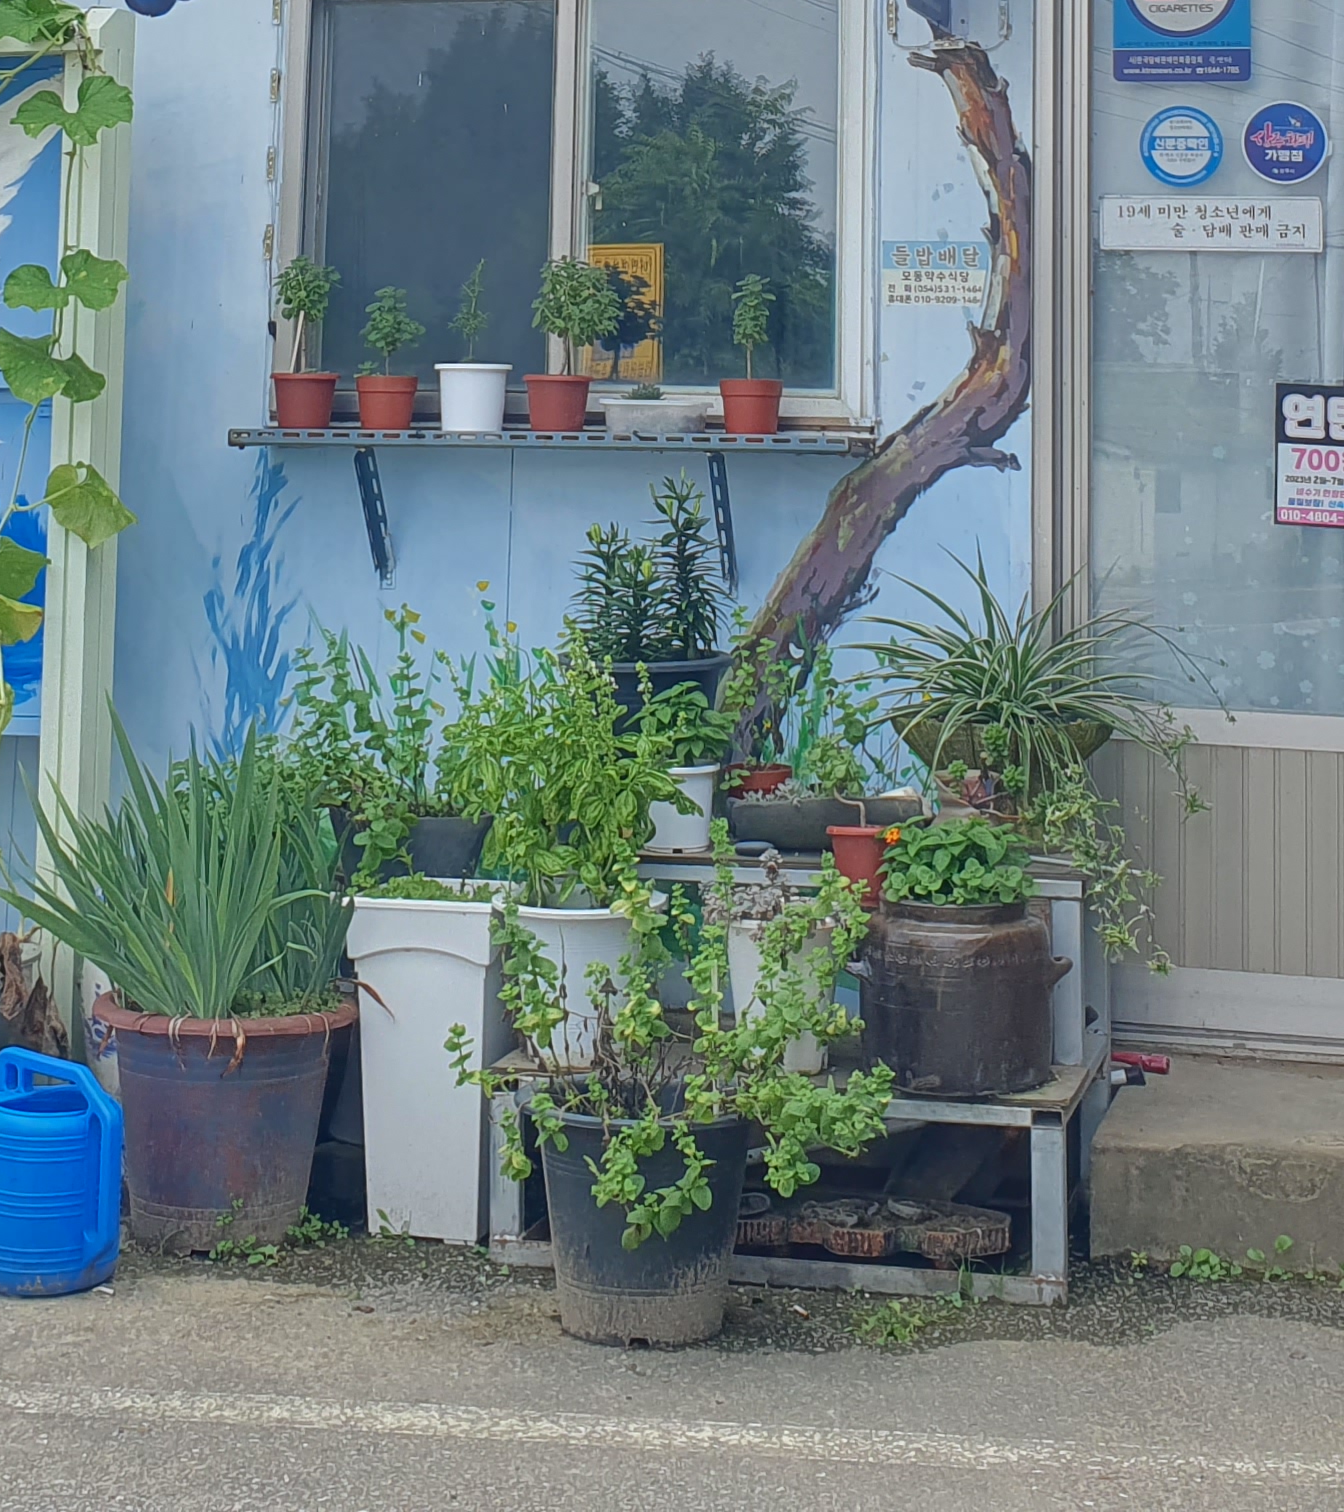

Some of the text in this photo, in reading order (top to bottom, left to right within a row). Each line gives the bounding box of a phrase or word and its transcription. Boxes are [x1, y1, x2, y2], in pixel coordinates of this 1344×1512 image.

[1148, 3, 1214, 13] CIGARETTES
[1264, 149, 1304, 162] 가맹점
[1117, 204, 1272, 221] 19세 미만 청소년에게
[1238, 223, 1270, 239] 판매
[1275, 223, 1307, 240] 금지
[891, 245, 980, 268] 들밥배달
[901, 270, 970, 283] 모동약수식당
